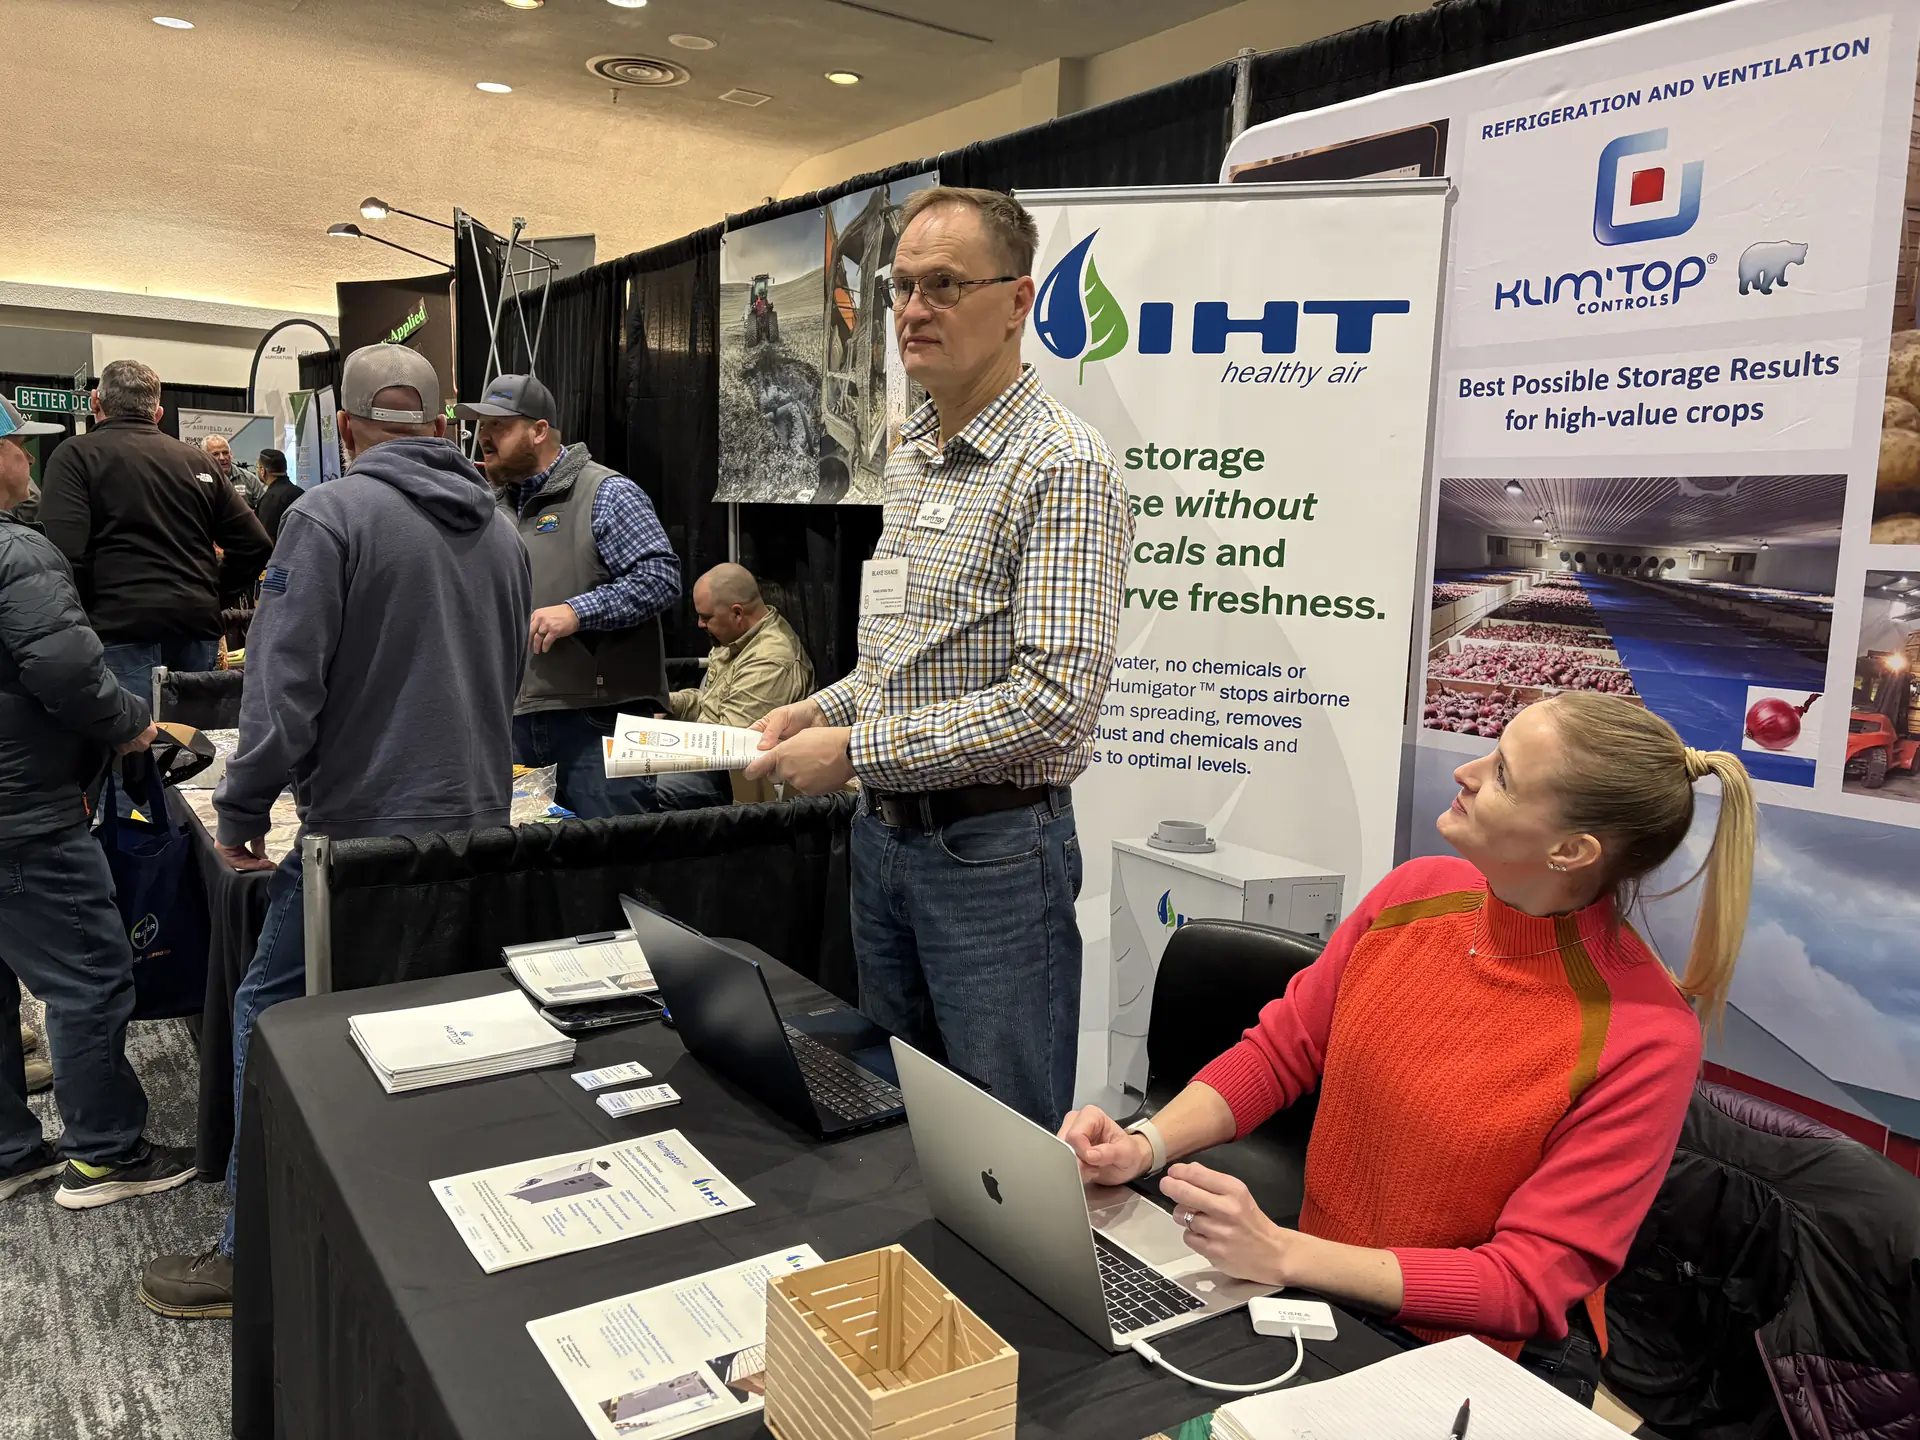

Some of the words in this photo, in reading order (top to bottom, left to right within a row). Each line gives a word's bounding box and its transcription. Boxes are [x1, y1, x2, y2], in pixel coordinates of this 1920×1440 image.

[1481, 91, 1641, 140] REFRIGERATION
[1648, 80, 1695, 103] AND
[1702, 37, 1870, 92] VENTILATION
[1577, 294, 1669, 315] CONTROLS
[1138, 300, 1411, 354] IHT
[1220, 361, 1322, 388] healthy
[1327, 362, 1367, 384] air
[1459, 377, 1505, 398] Best
[1512, 369, 1609, 395] Possible
[1617, 363, 1720, 390] Storage
[1730, 352, 1840, 381] Results
[21, 390, 67, 409] BETTER
[71, 394, 93, 411] DEC
[193, 424, 222, 432] AIRFIELD
[1505, 409, 1538, 431] for
[1544, 404, 1677, 433] high-value
[1686, 402, 1764, 427] crops
[1124, 443, 1265, 479] storage
[1128, 494, 1164, 517] se
[1175, 489, 1318, 521] without
[1133, 536, 1206, 565] cals
[1216, 538, 1286, 567] and
[1124, 587, 1178, 611] rve
[1188, 582, 1386, 620] freshness.
[1165, 659, 1187, 672] no
[1192, 659, 1282, 678] chemicals
[1287, 665, 1306, 679] or
[1219, 685, 1268, 703] stops
[1273, 687, 1350, 707] airborne
[1100, 704, 1125, 717] om
[1130, 705, 1220, 726] spreading,
[1226, 711, 1302, 729] removes
[1132, 728, 1164, 743] and
[1170, 729, 1258, 750] chemicals
[1264, 736, 1298, 753] and
[1107, 751, 1123, 764] to
[1128, 753, 1191, 770] optimal
[1197, 756, 1251, 774] levels.
[699, 1187, 728, 1207] IHT
